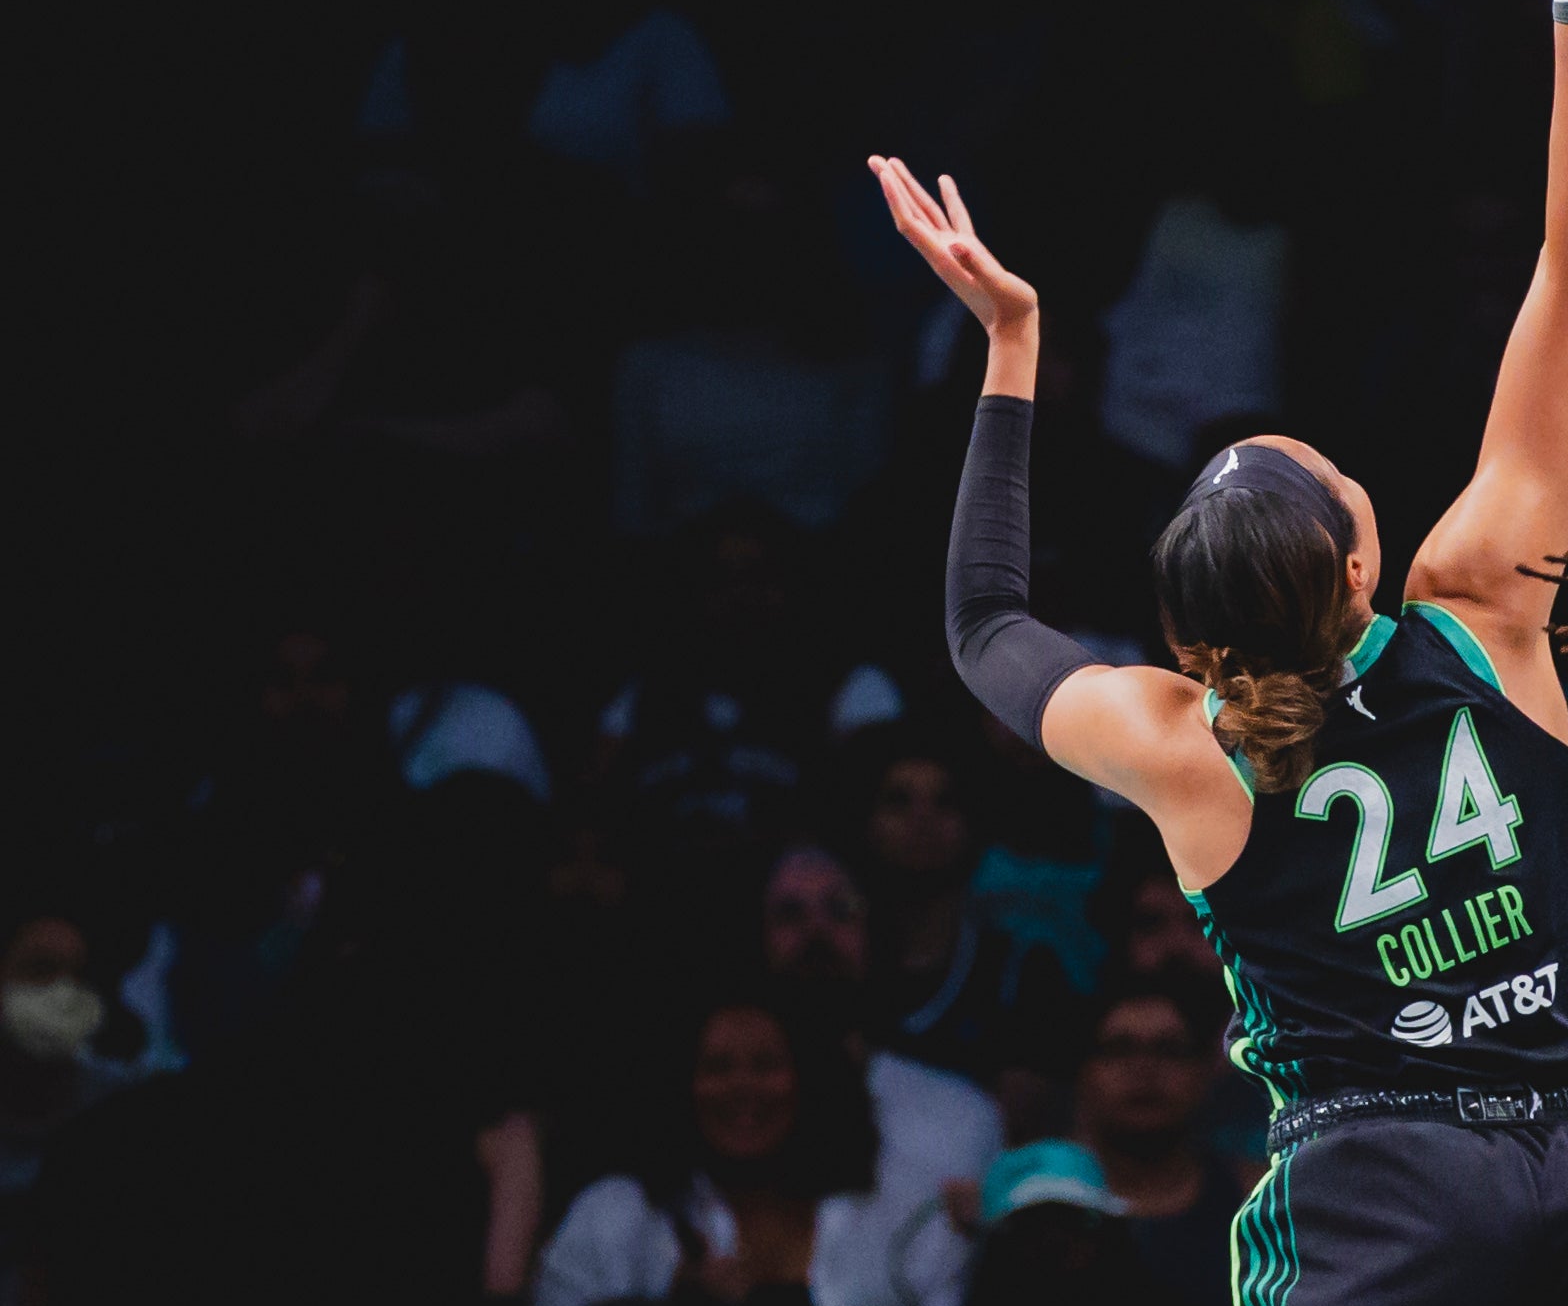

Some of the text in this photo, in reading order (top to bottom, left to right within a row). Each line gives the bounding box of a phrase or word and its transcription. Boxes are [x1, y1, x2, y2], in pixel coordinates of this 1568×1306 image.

[1295, 706, 1524, 933] 24
[1376, 883, 1533, 987] COLLIER
[1462, 962, 1558, 1039] AT&T
